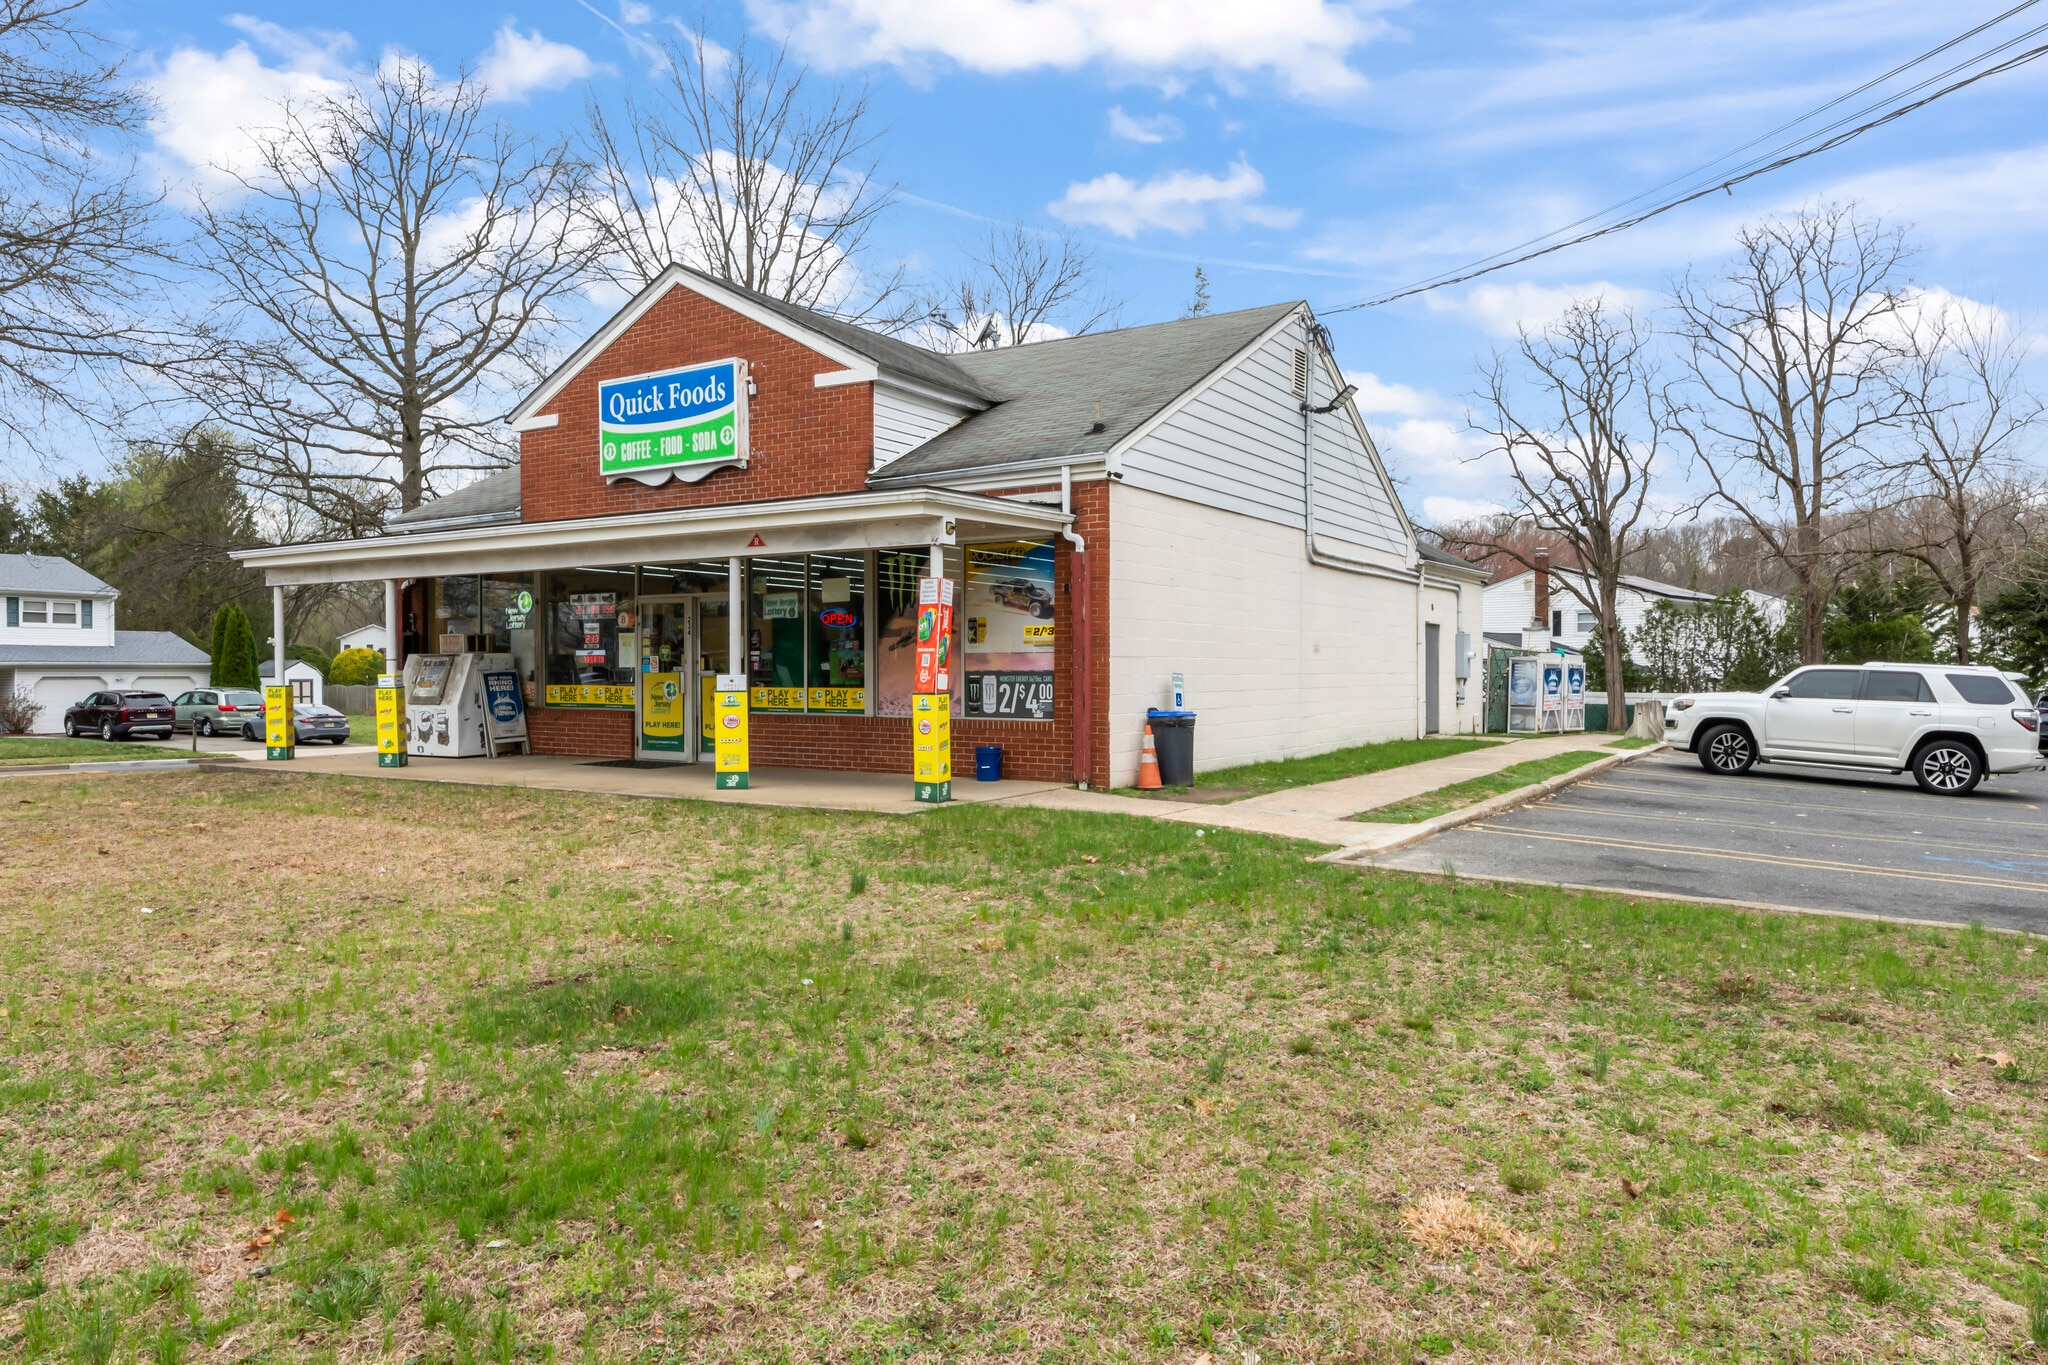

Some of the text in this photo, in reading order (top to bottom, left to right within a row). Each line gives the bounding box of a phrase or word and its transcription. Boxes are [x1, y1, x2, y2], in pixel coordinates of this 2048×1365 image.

[609, 375, 726, 422] Quick Foods
[621, 440, 651, 462] COFFEE
[660, 435, 683, 457] FOOD
[692, 430, 717, 452] SODA
[754, 537, 760, 546] R
[764, 598, 797, 607] New Jersey
[505, 607, 519, 615] New
[764, 607, 788, 617] Lottery
[508, 614, 526, 622] Jersey
[821, 613, 853, 625] OPEN
[506, 621, 526, 630] Lottery
[560, 687, 577, 695] PLAY
[604, 688, 624, 696] PLAY
[767, 689, 789, 699] PLAY
[824, 690, 849, 699] PLAY
[560, 694, 577, 702] HERE
[604, 695, 624, 703] HERE
[767, 698, 789, 707] HERE
[824, 699, 848, 708] HERE
[662, 721, 681, 729] HERE!
